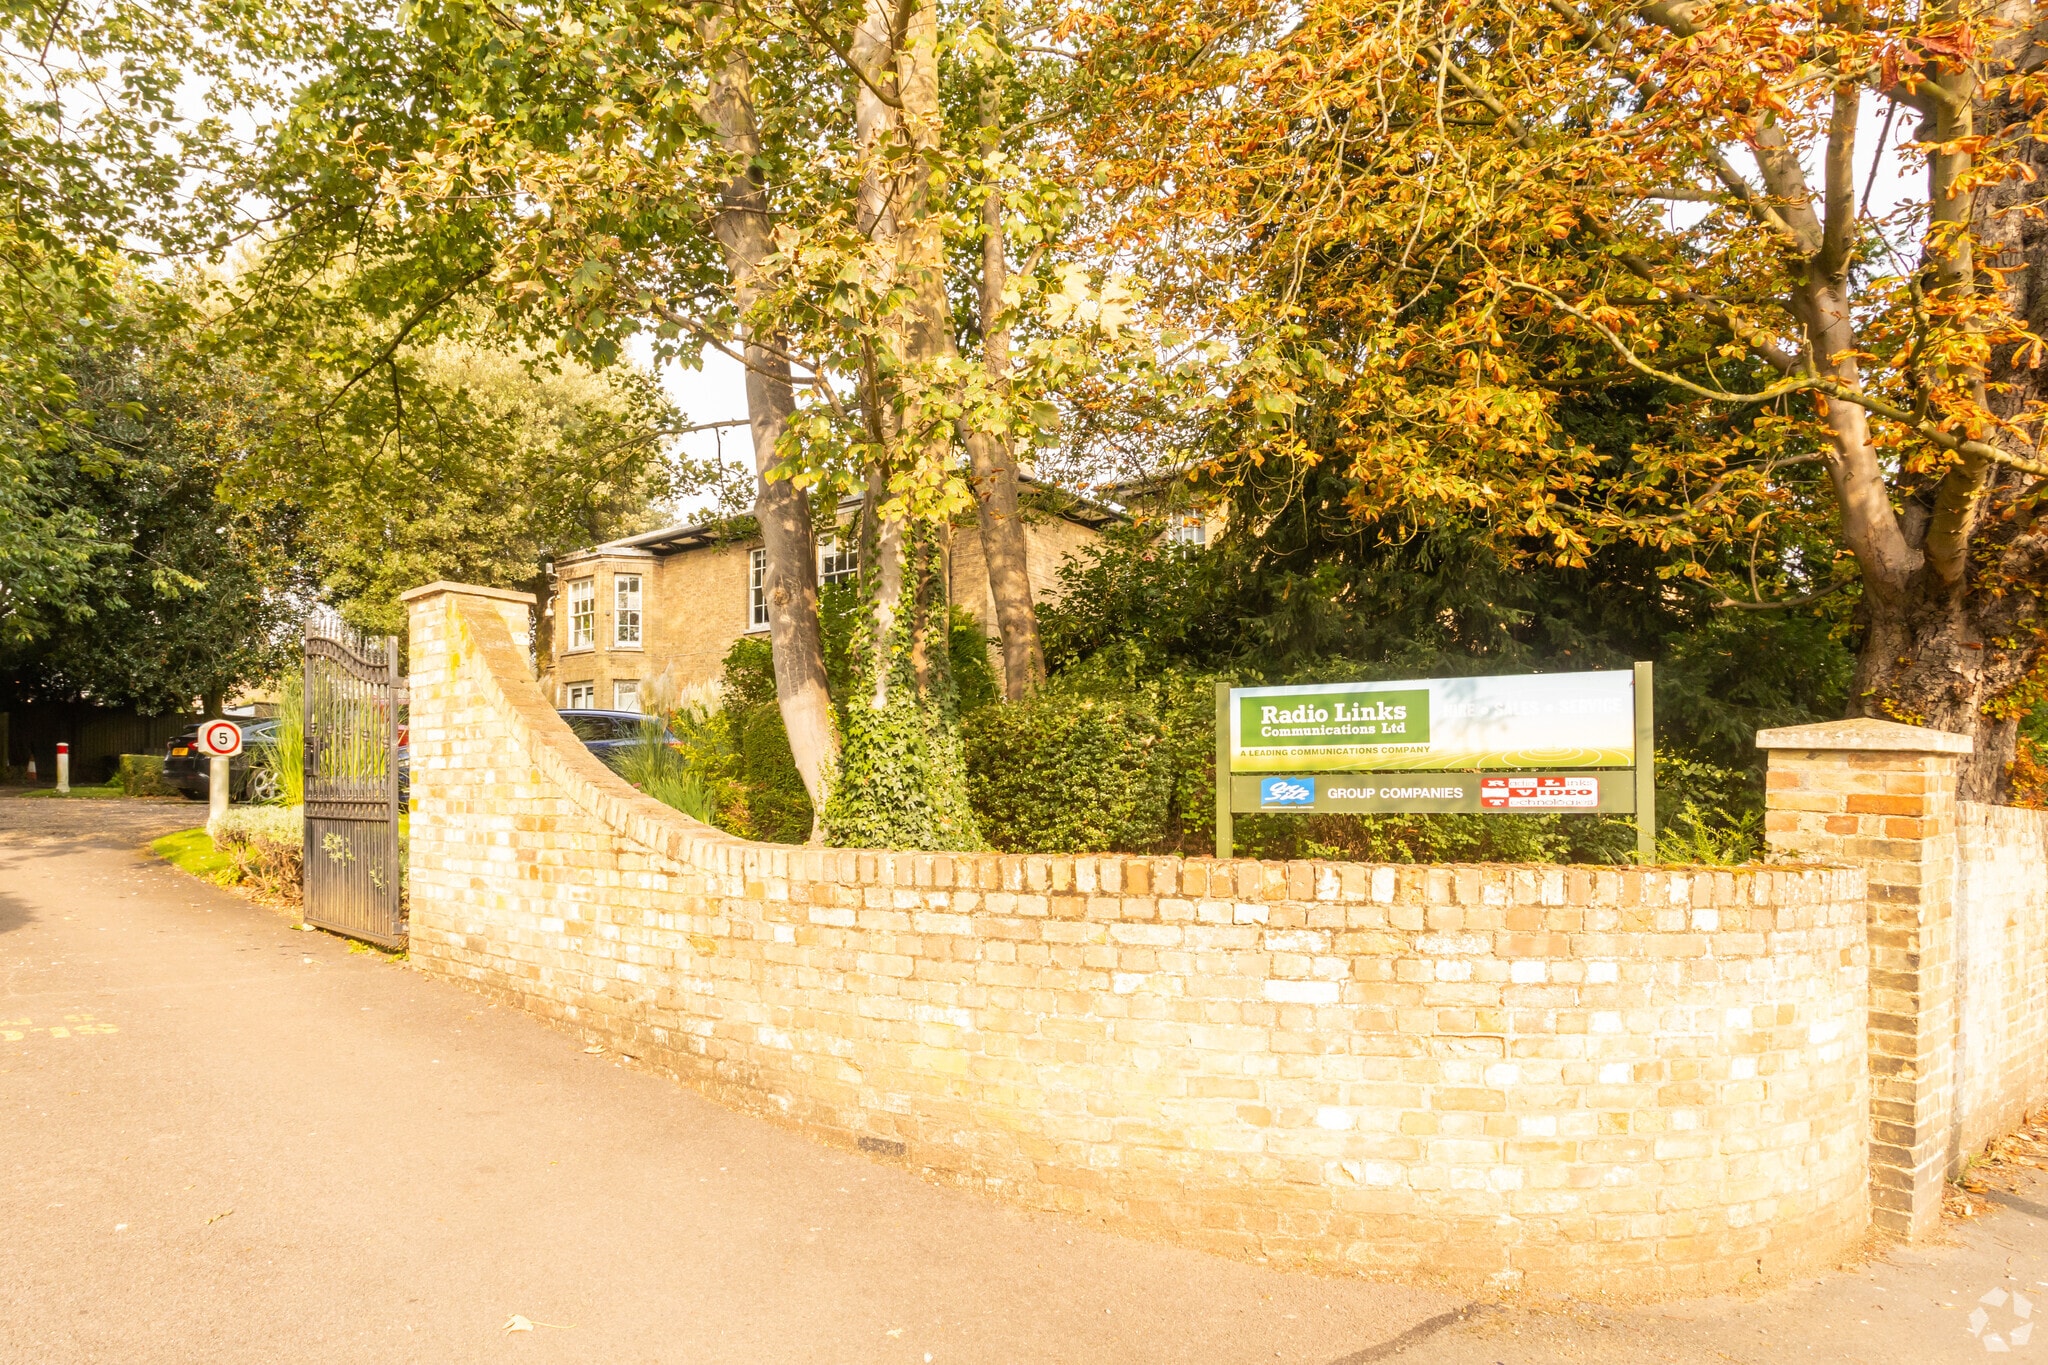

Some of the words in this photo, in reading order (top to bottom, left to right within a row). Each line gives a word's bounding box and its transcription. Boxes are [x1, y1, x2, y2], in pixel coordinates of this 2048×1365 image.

[1260, 704, 1329, 724] Radio
[1334, 701, 1407, 723] Links
[1444, 703, 1475, 718] HIRE
[1494, 700, 1540, 717] SALES
[1560, 698, 1622, 714] SERVICE
[1261, 724, 1376, 737] Communications
[1381, 722, 1406, 734] Ltd
[219, 732, 228, 745] 5
[1249, 749, 1289, 757] LEADING
[1290, 747, 1379, 756] COMMUNICATIONS
[1381, 746, 1431, 755] COMPANY
[1327, 787, 1376, 799] GROUP
[1379, 787, 1464, 799] COMPANIES
[1516, 789, 1593, 797] VIDEO
